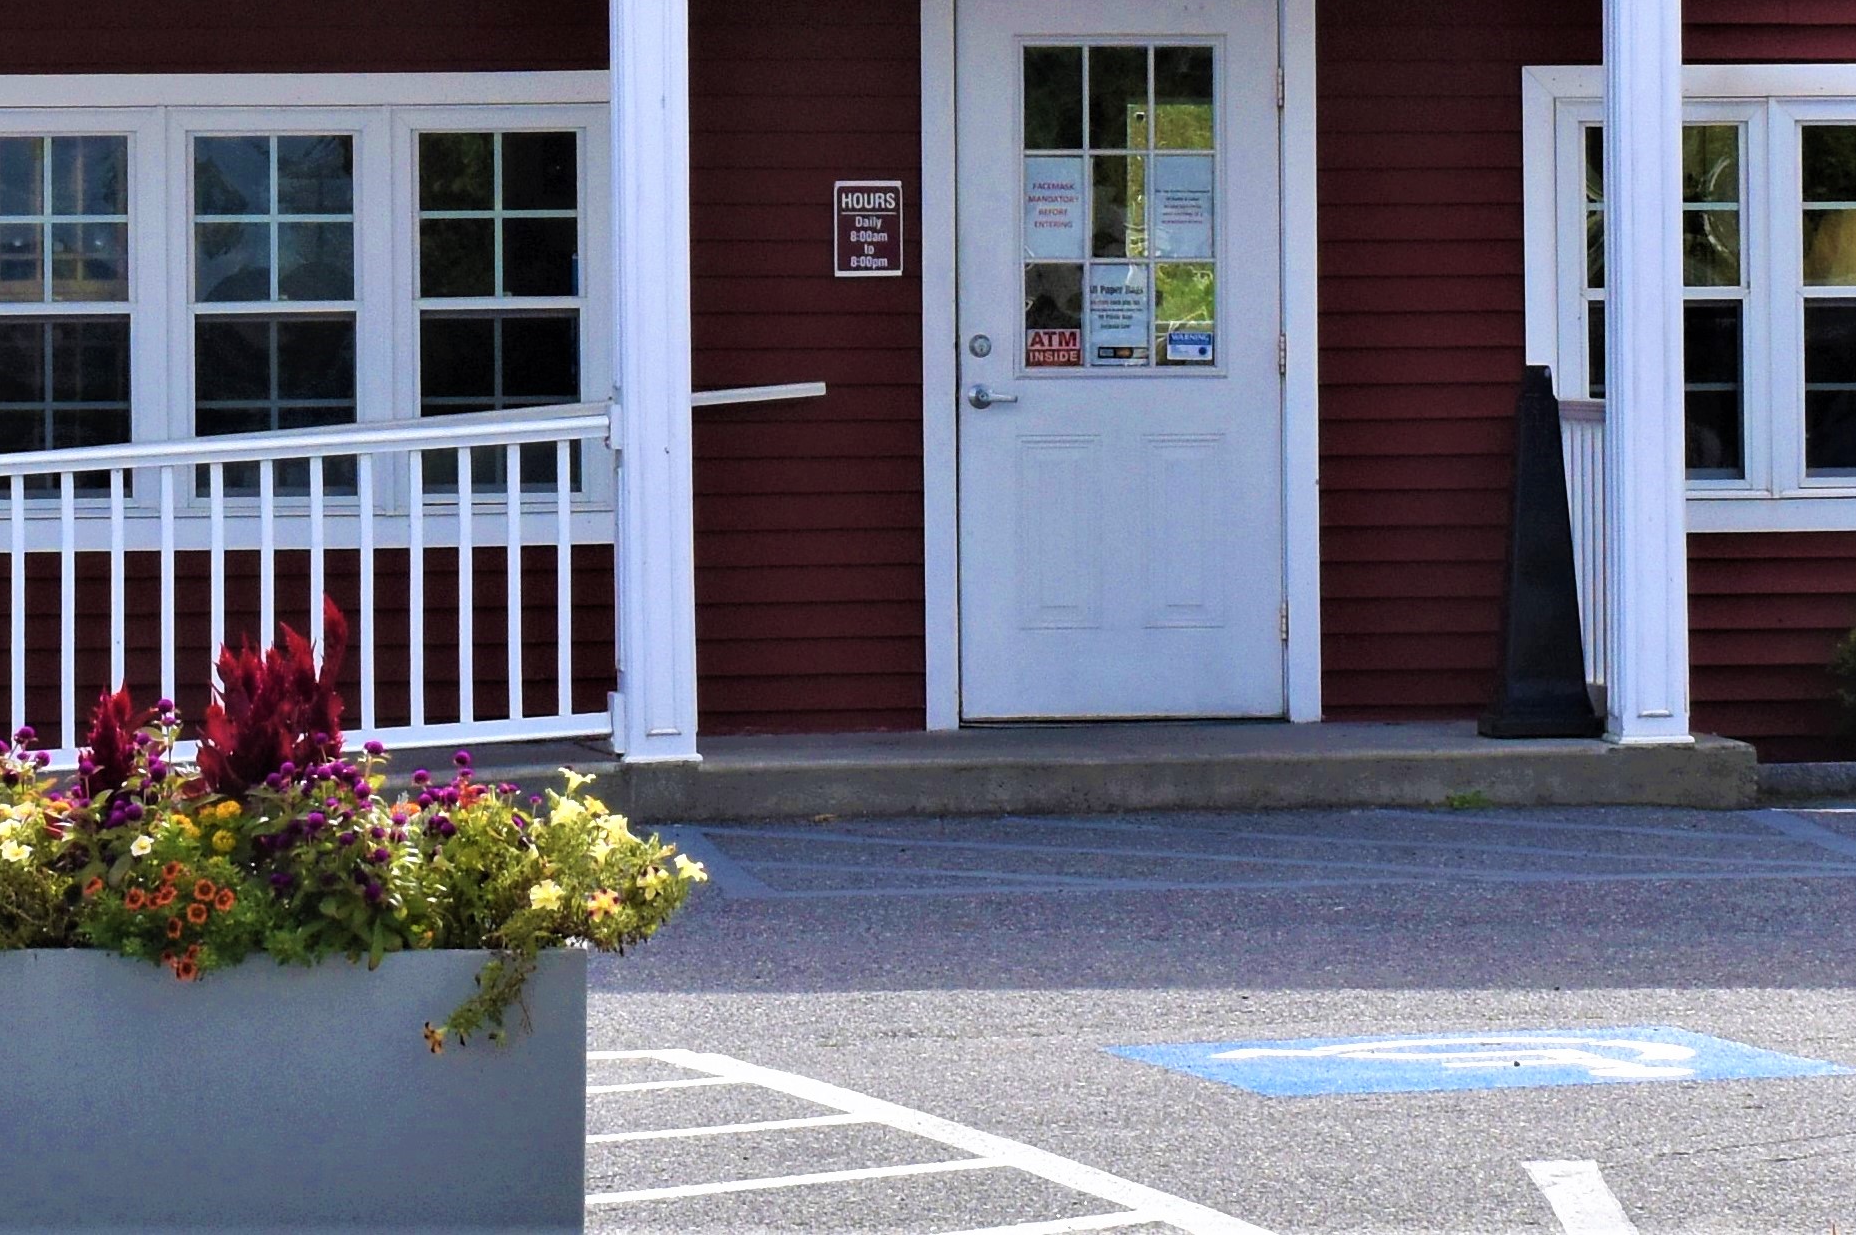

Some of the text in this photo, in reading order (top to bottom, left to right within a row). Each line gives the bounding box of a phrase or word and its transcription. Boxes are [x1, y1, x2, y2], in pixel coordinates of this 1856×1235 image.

[841, 192, 896, 209] HOURS
[1028, 195, 1079, 203] MANDATORY
[1038, 207, 1068, 216] BEFORE
[855, 216, 882, 229] Daily
[1034, 220, 1073, 228] ENTERING
[850, 231, 888, 242] 8:00am
[864, 244, 875, 254] to
[850, 256, 888, 269] 8:00pm
[1100, 285, 1123, 295] Paper
[1029, 331, 1077, 347] ATM
[1171, 333, 1210, 341] WARNING
[1029, 351, 1078, 362] INSIDE
